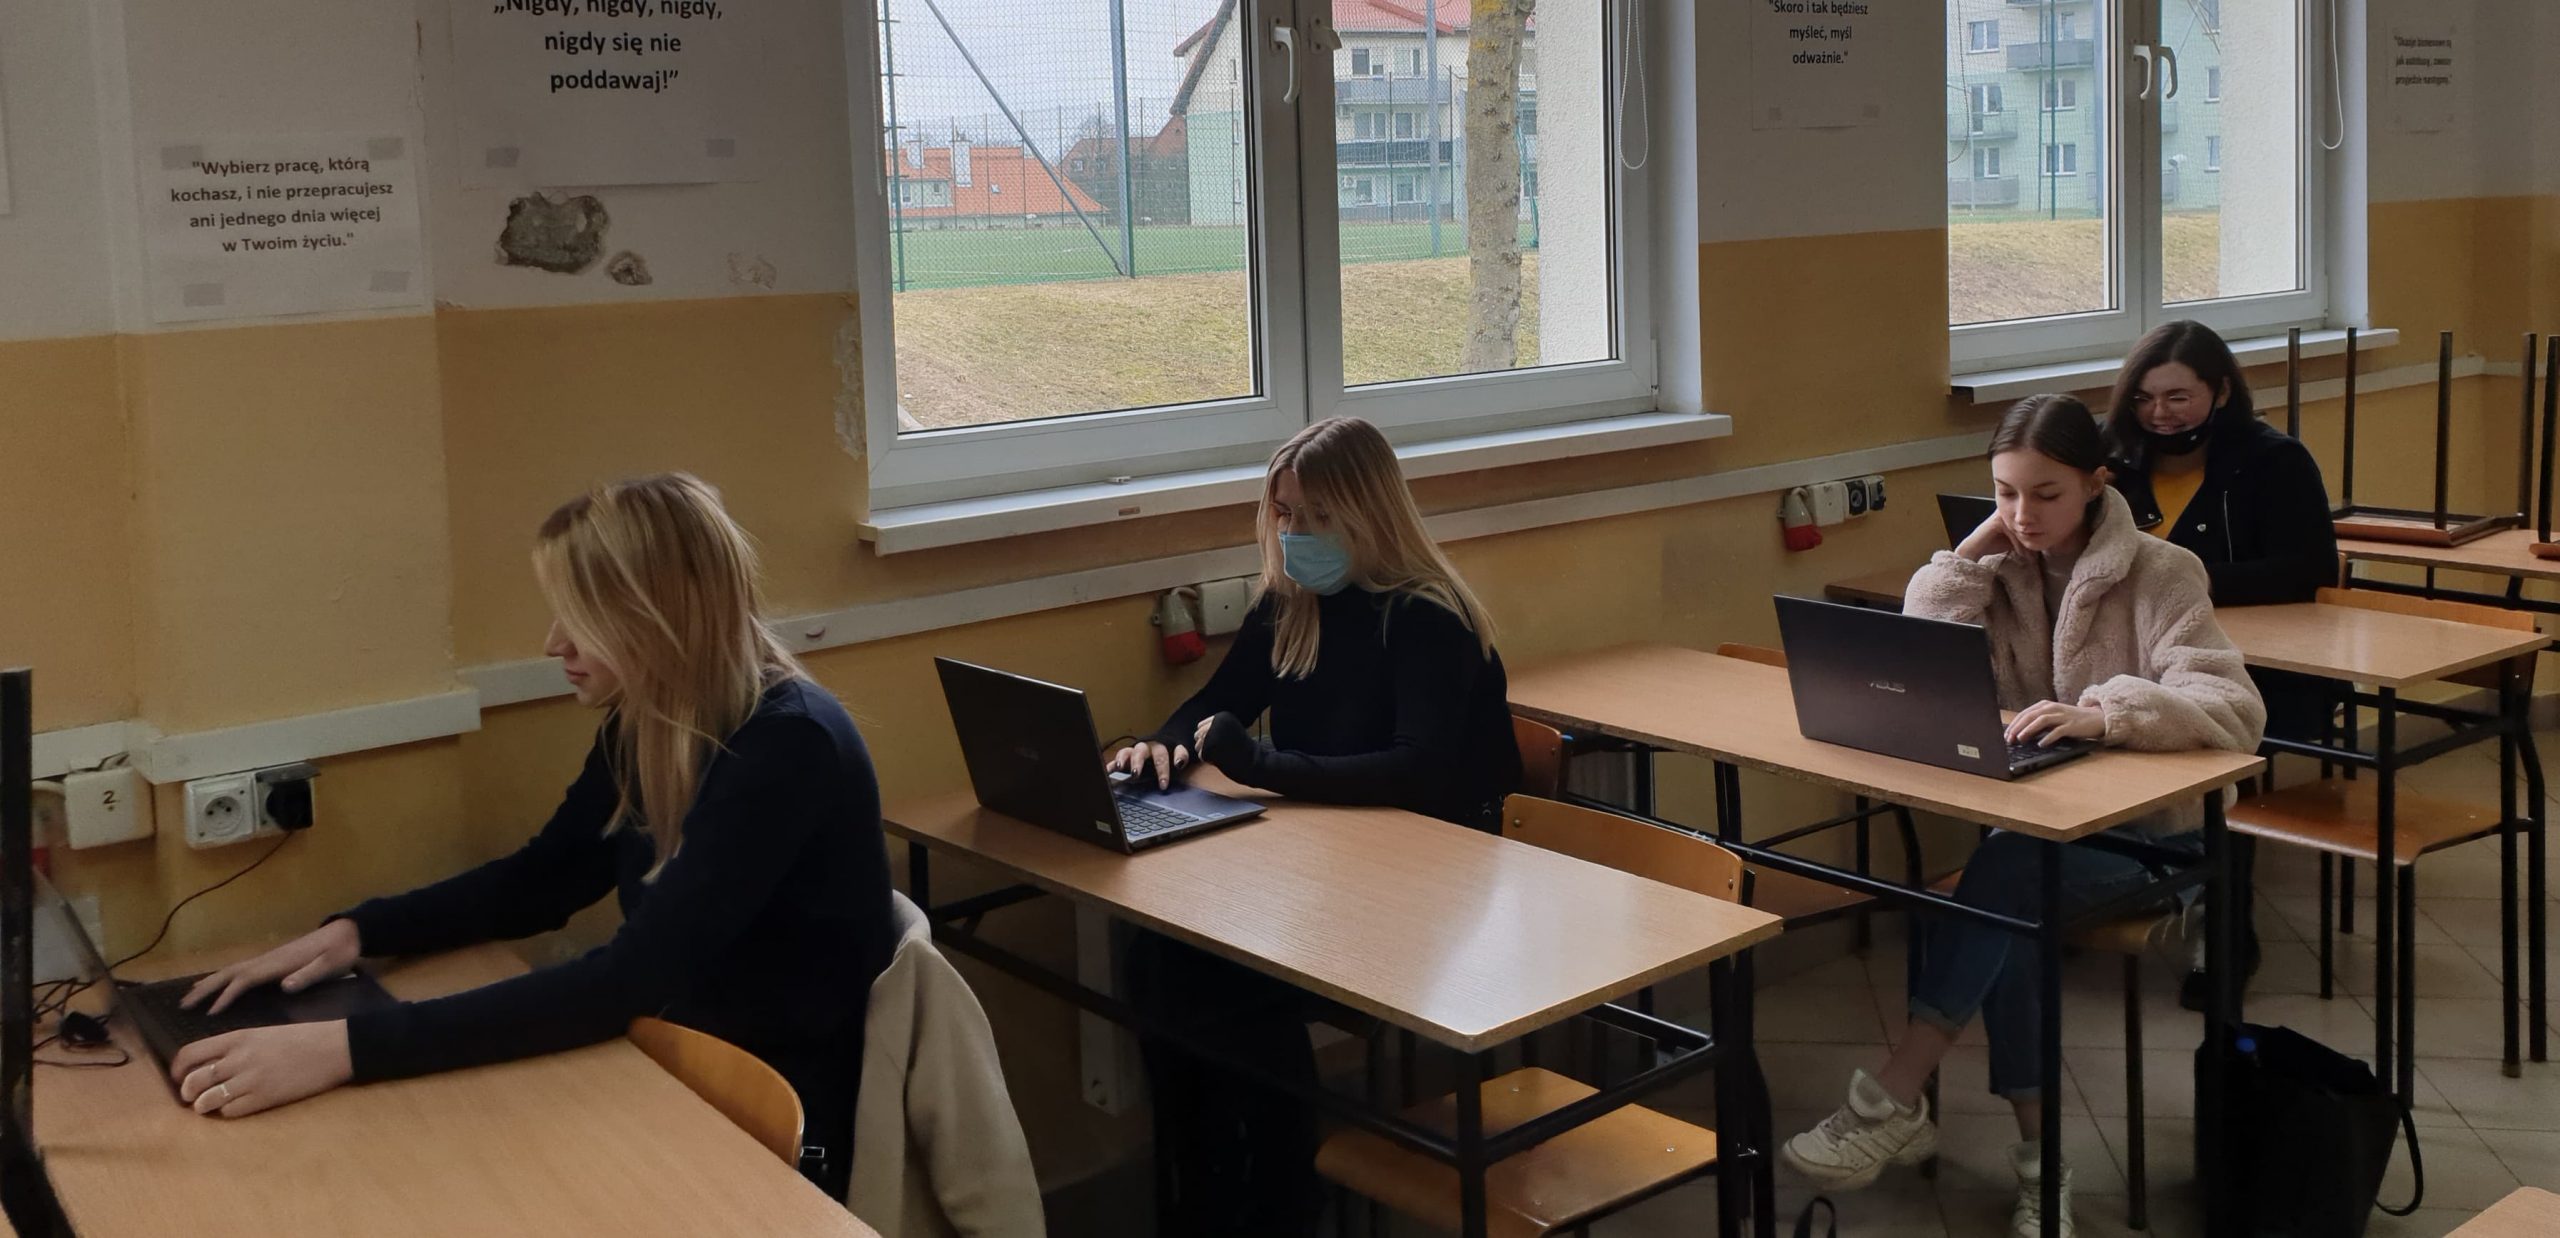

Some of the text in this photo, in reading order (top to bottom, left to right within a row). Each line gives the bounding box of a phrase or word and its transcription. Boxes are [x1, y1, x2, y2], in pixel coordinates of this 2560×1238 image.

[586, 0, 654, 18] nigdy,
[660, 0, 723, 20] nigdy,
[1806, 1, 1810, 14] i
[1812, 1, 1829, 14] tak
[1831, 1, 1869, 16] będziesz
[544, 31, 682, 56] nigdy się nie
[1789, 25, 1852, 42] myśleć, myśl
[191, 157, 370, 177] "Wybierz pracę, którą
[170, 182, 394, 203] kochasz, i nie przepracujesz
[189, 206, 381, 230] ani jednego dnia więcej
[221, 232, 354, 253] w Twoim życiu."
